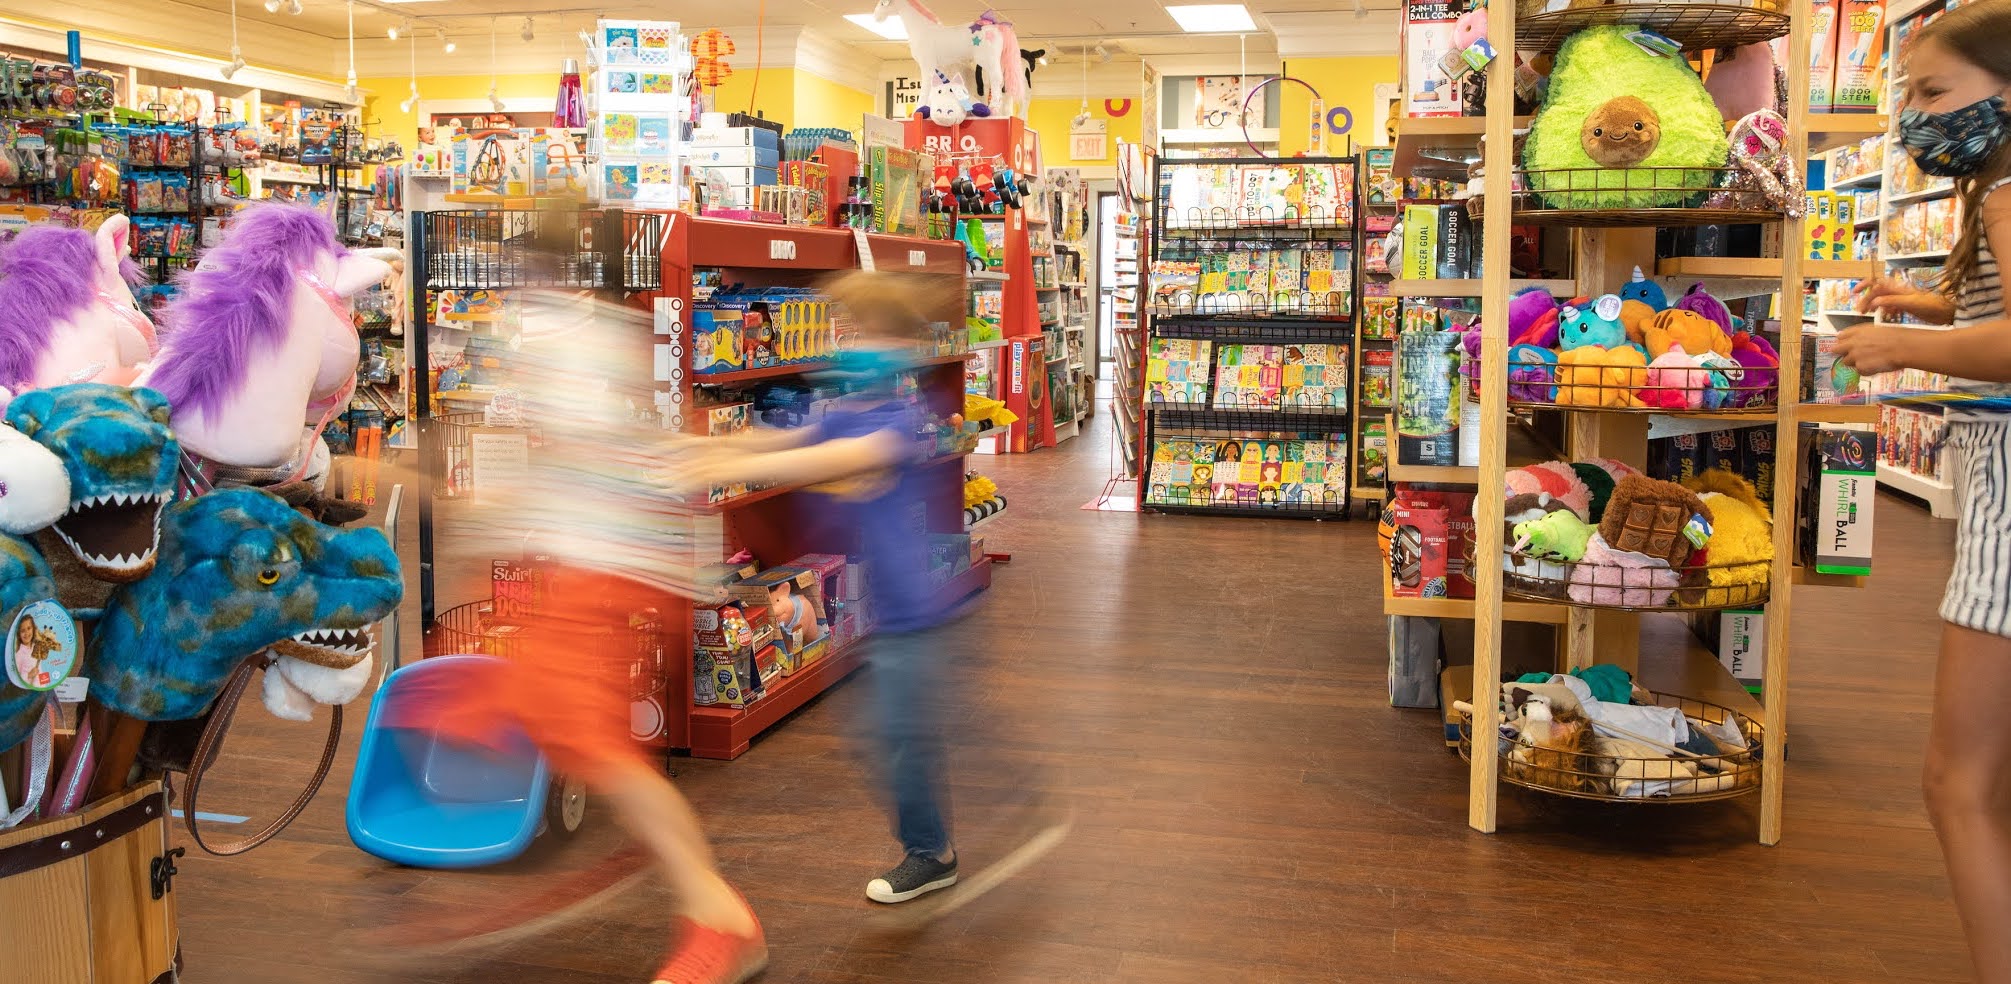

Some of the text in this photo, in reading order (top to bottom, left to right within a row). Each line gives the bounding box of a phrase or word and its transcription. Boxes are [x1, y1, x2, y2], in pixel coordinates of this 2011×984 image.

[1410, 4, 1432, 12] 2-IN-1
[1410, 11, 1462, 20] BALL COMBO
[1850, 16, 1875, 27] 100
[896, 93, 920, 104] MIS
[923, 135, 976, 152] BRO
[1077, 138, 1101, 156] EXIT
[874, 182, 884, 197] Slip
[1247, 173, 1258, 216] DOT-TO-DOT
[874, 206, 884, 228] Slide
[1447, 211, 1458, 267] SOCCER GOAL
[1419, 226, 1429, 279] SOCCER GOAL
[1817, 390, 1834, 398] WATER
[1835, 479, 1849, 551] WHIRL BALL
[493, 567, 532, 581] Swirl
[1733, 617, 1743, 674] WHIRL BALL
